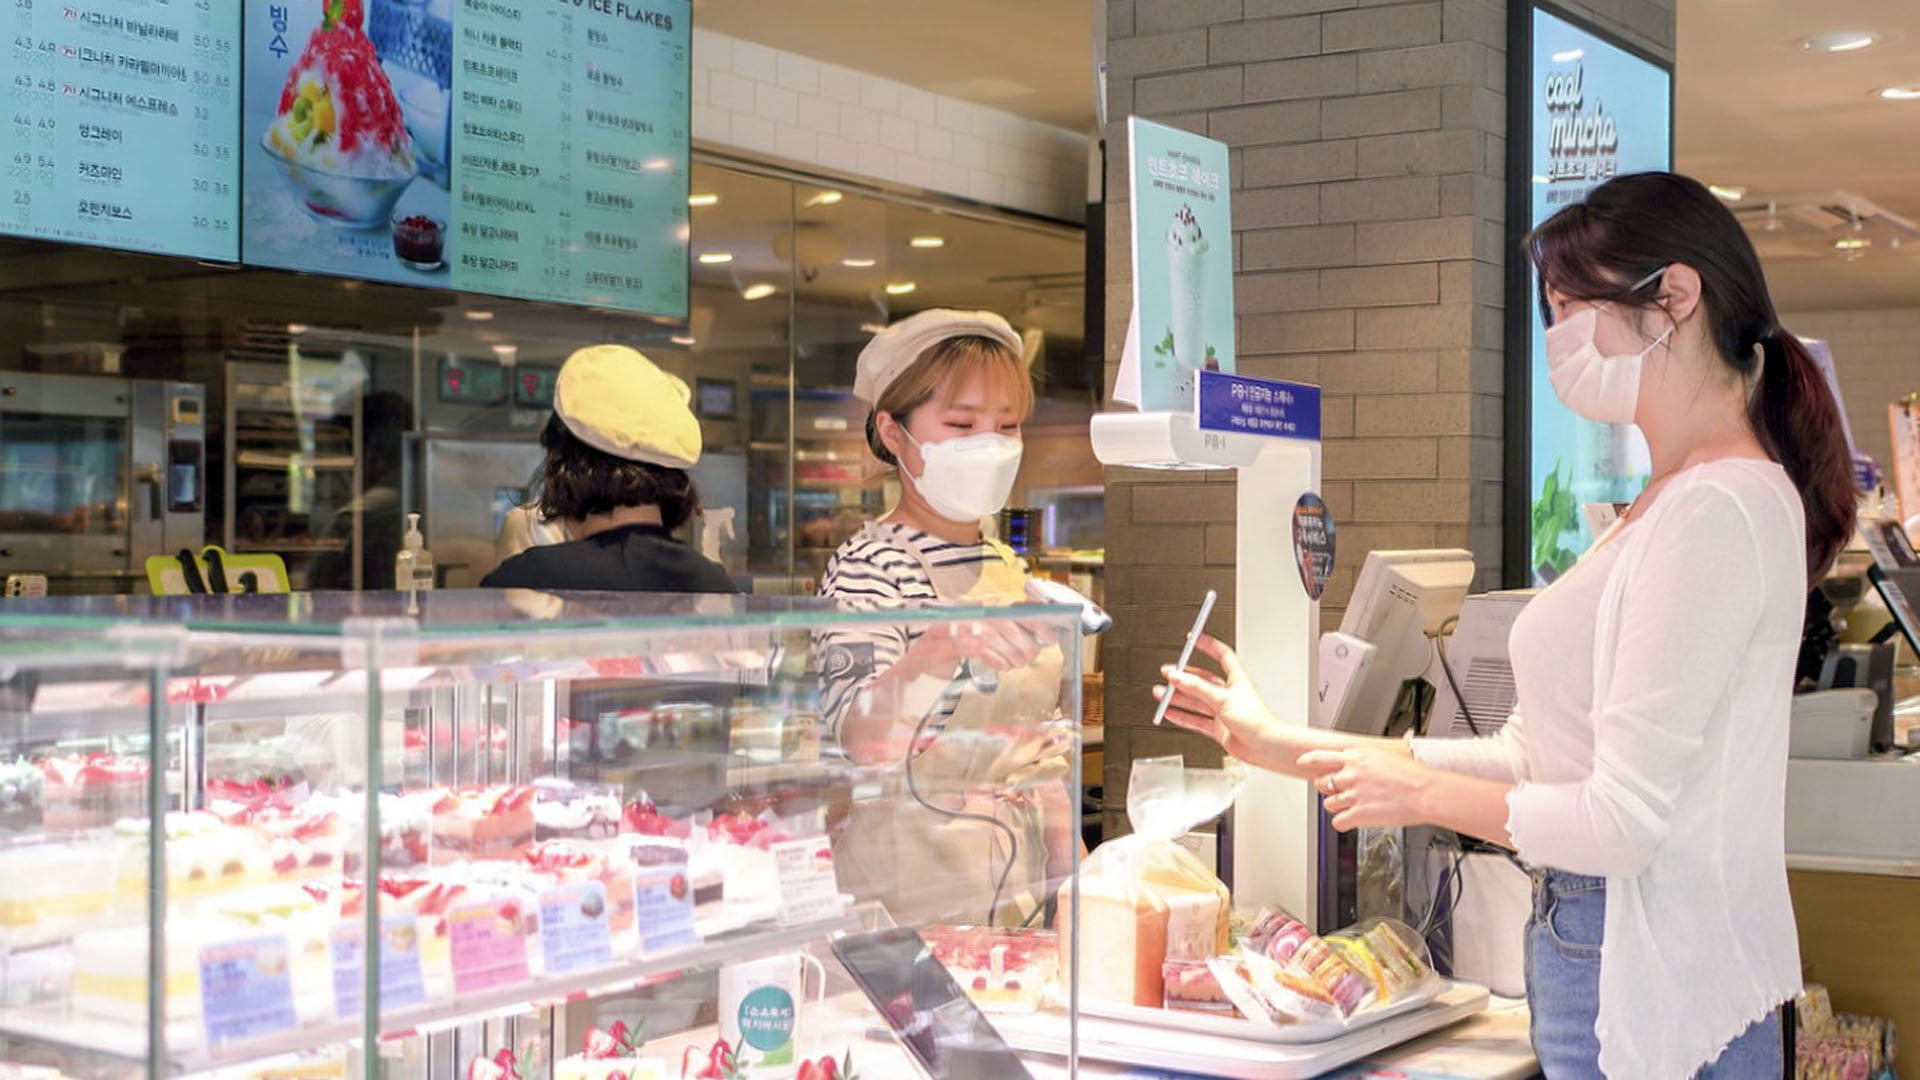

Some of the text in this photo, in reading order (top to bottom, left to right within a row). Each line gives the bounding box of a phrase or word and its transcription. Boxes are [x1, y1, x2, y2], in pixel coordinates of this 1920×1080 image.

[80, 11, 123, 31] 시그니처
[269, 6, 288, 58] 빙수
[589, 0, 672, 32] ICE FLAKES
[79, 86, 123, 105] 시그니처
[1545, 61, 1582, 107] cool
